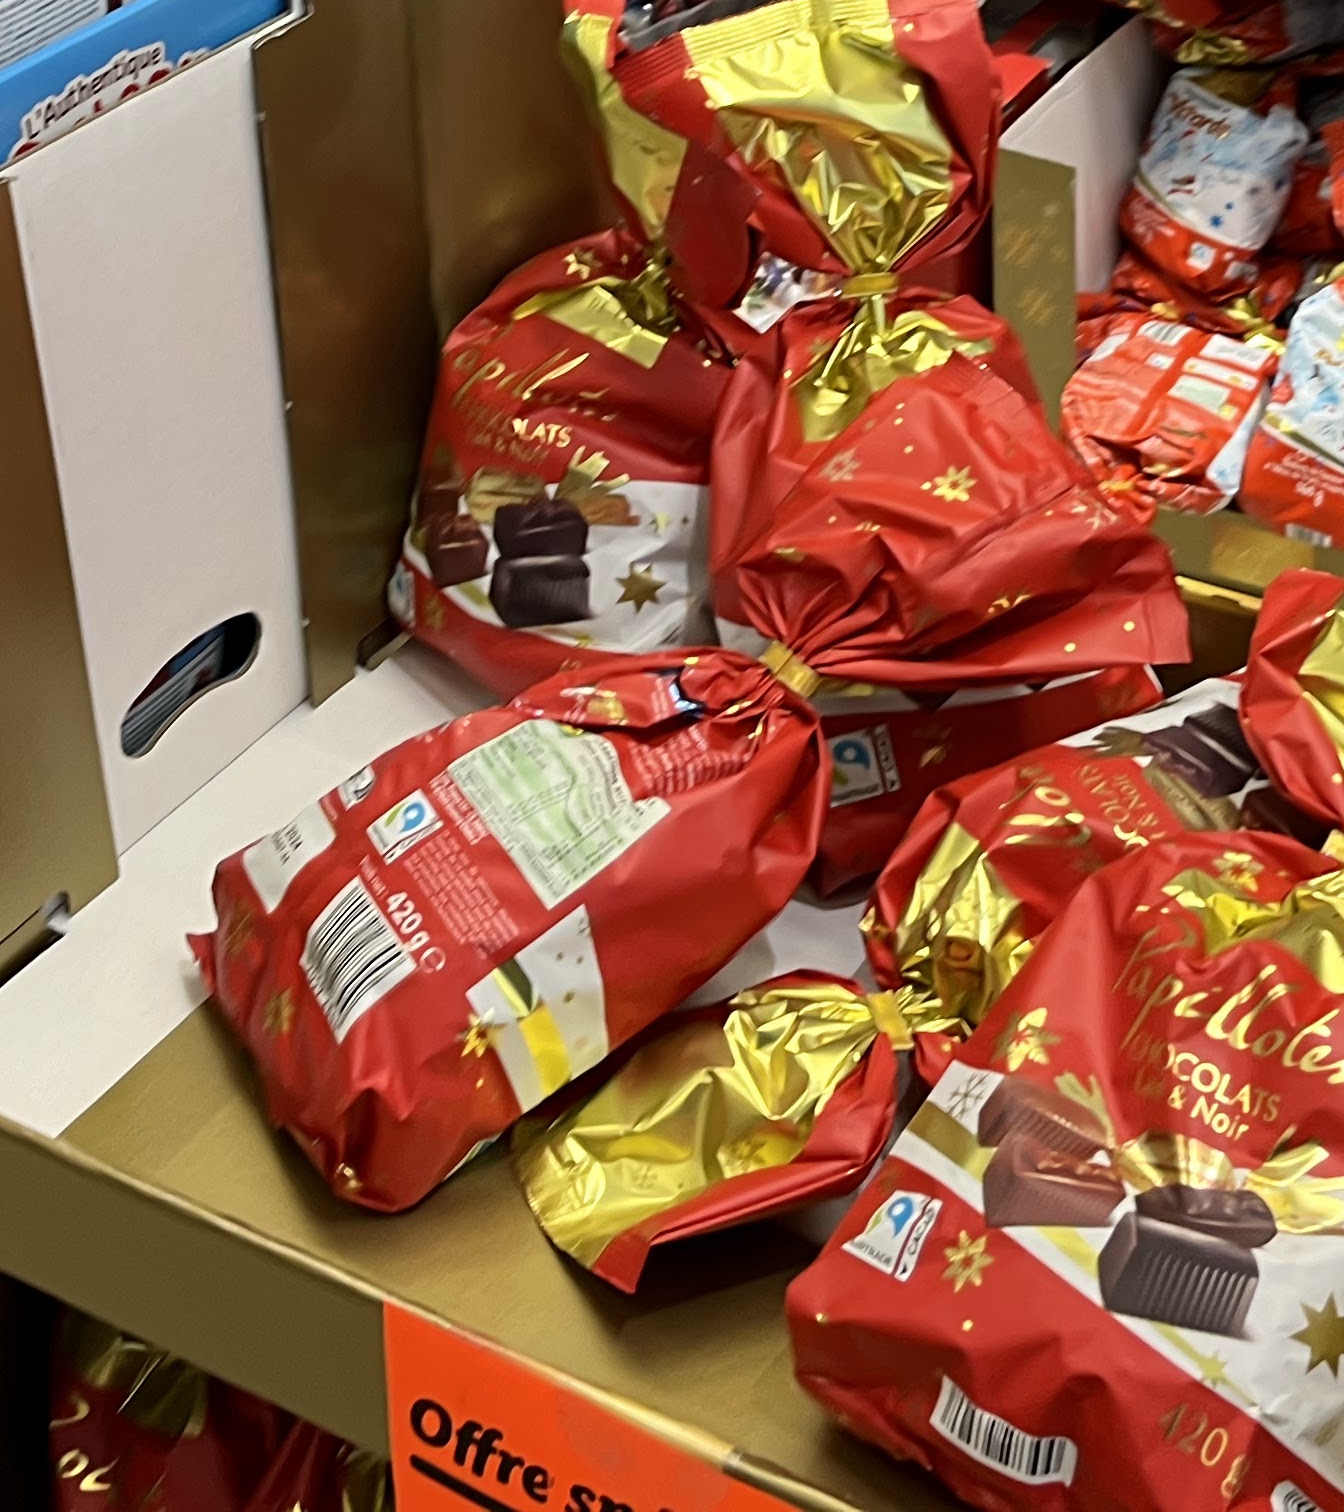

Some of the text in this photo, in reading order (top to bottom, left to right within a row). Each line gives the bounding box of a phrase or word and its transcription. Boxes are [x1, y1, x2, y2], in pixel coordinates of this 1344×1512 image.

[385, 891, 424, 935] 420
[1190, 1095, 1250, 1141] Noir
[408, 1397, 555, 1504] Offre
